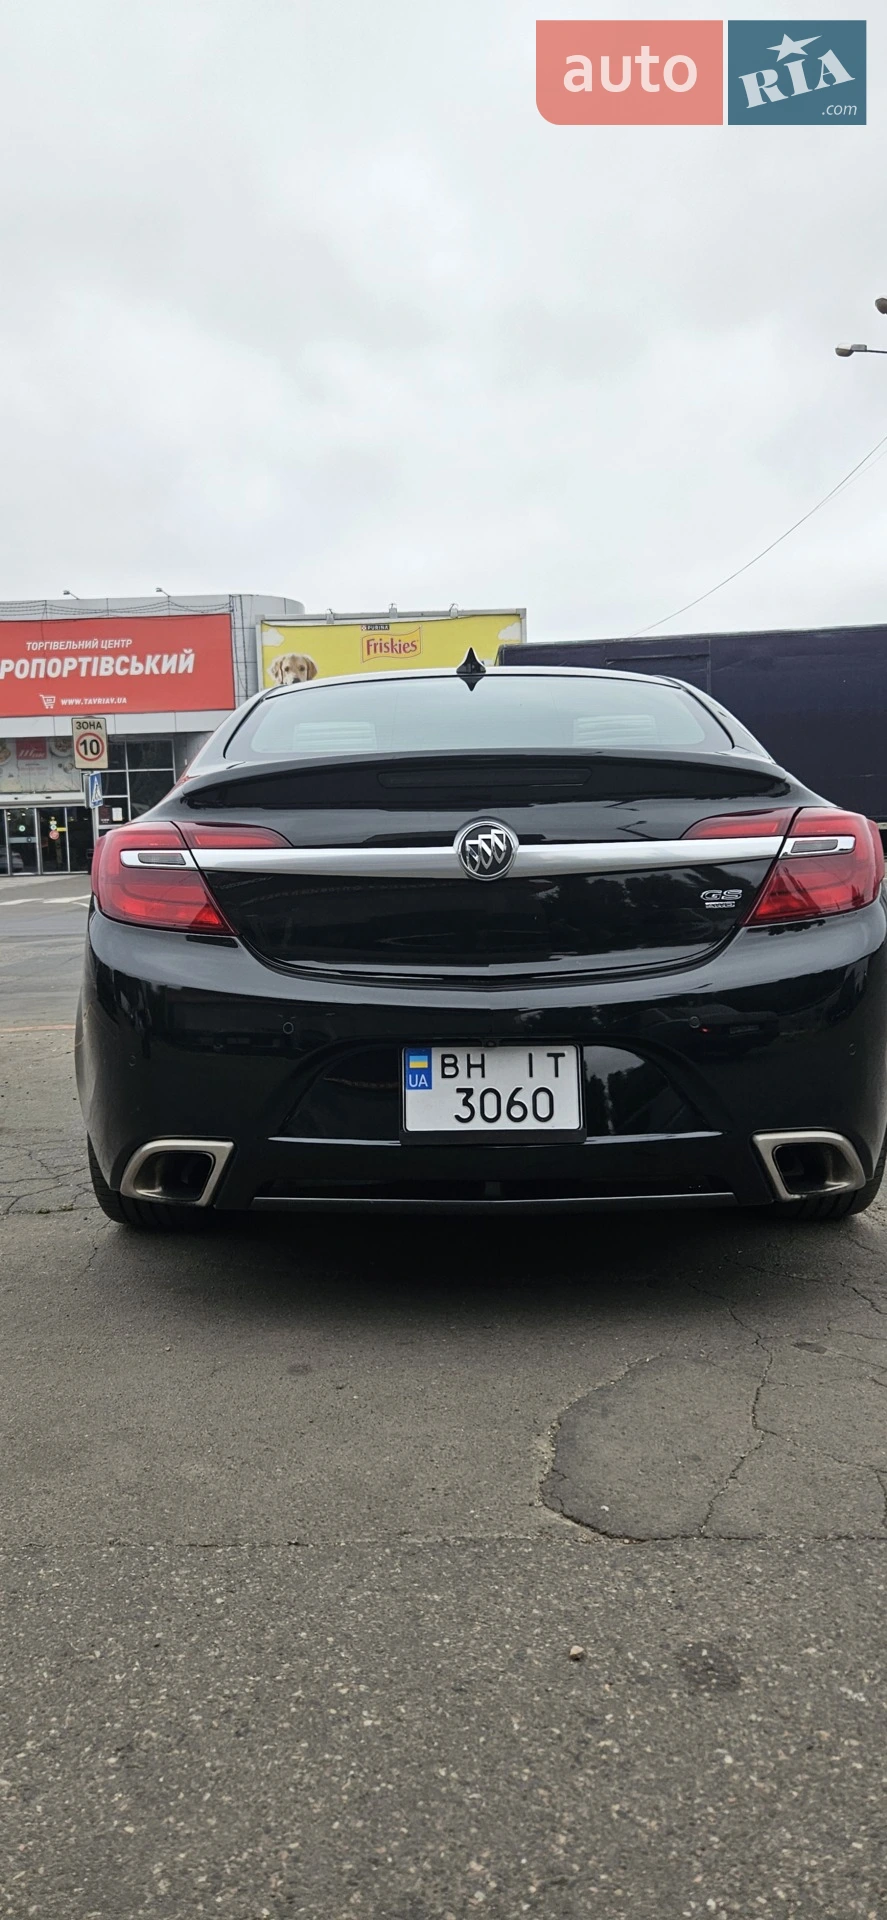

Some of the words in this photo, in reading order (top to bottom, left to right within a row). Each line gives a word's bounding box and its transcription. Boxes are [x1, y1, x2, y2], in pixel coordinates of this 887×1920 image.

[26, 639, 99, 651] ТОРГІВЕЛЬНИЙ
[101, 639, 133, 650] ЦЕНТР
[366, 638, 418, 656] Friskies
[0, 648, 196, 680] РОПОРТІВСЬКИЙ
[60, 697, 128, 706] WWW.TAVRIAV.UA
[76, 721, 103, 730] ЗОНА
[80, 739, 100, 756] 10
[700, 889, 743, 901] GS
[441, 1053, 486, 1079] BH
[408, 1074, 429, 1088] UA
[454, 1086, 555, 1124] 3060
